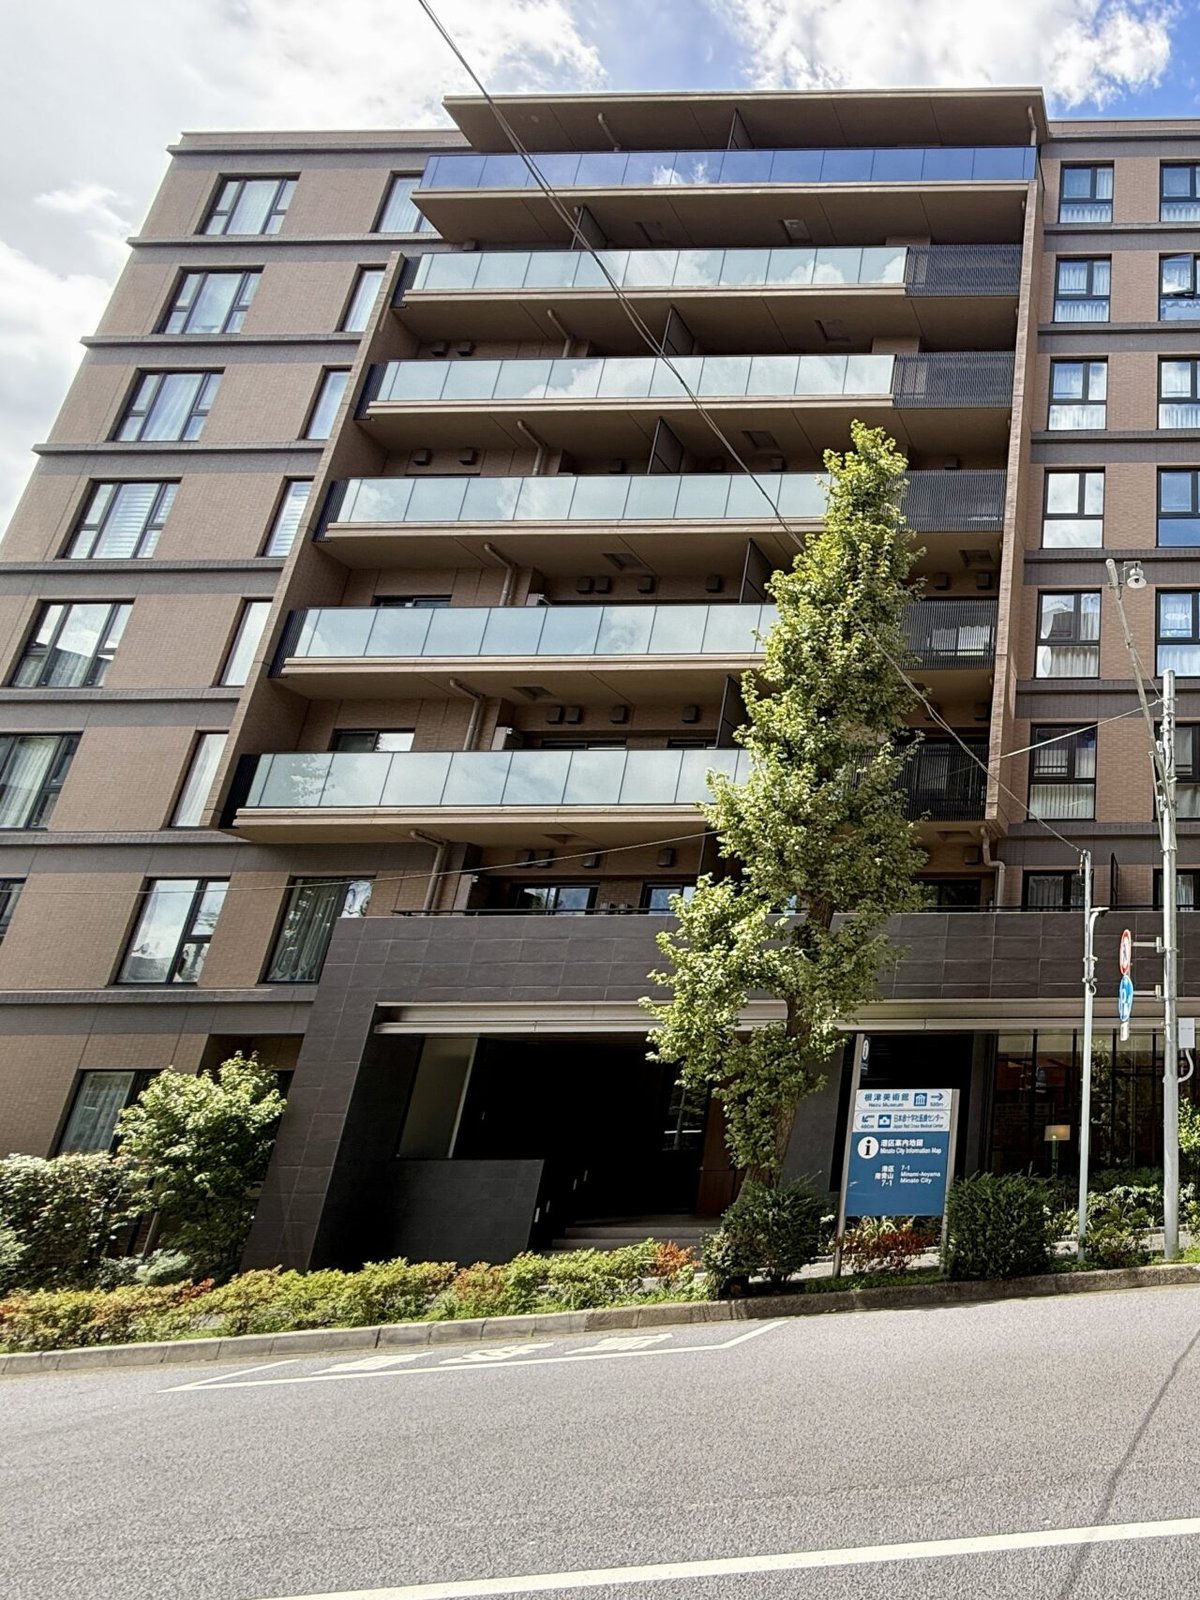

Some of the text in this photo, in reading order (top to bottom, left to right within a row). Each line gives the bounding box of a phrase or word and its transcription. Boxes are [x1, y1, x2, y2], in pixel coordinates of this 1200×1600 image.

[864, 1093, 909, 1101] 根津美術館
[893, 1114, 944, 1122] 日本赤十字社医療センター
[880, 1139, 924, 1148] 港区案内地図
[920, 1177, 932, 1185] City
